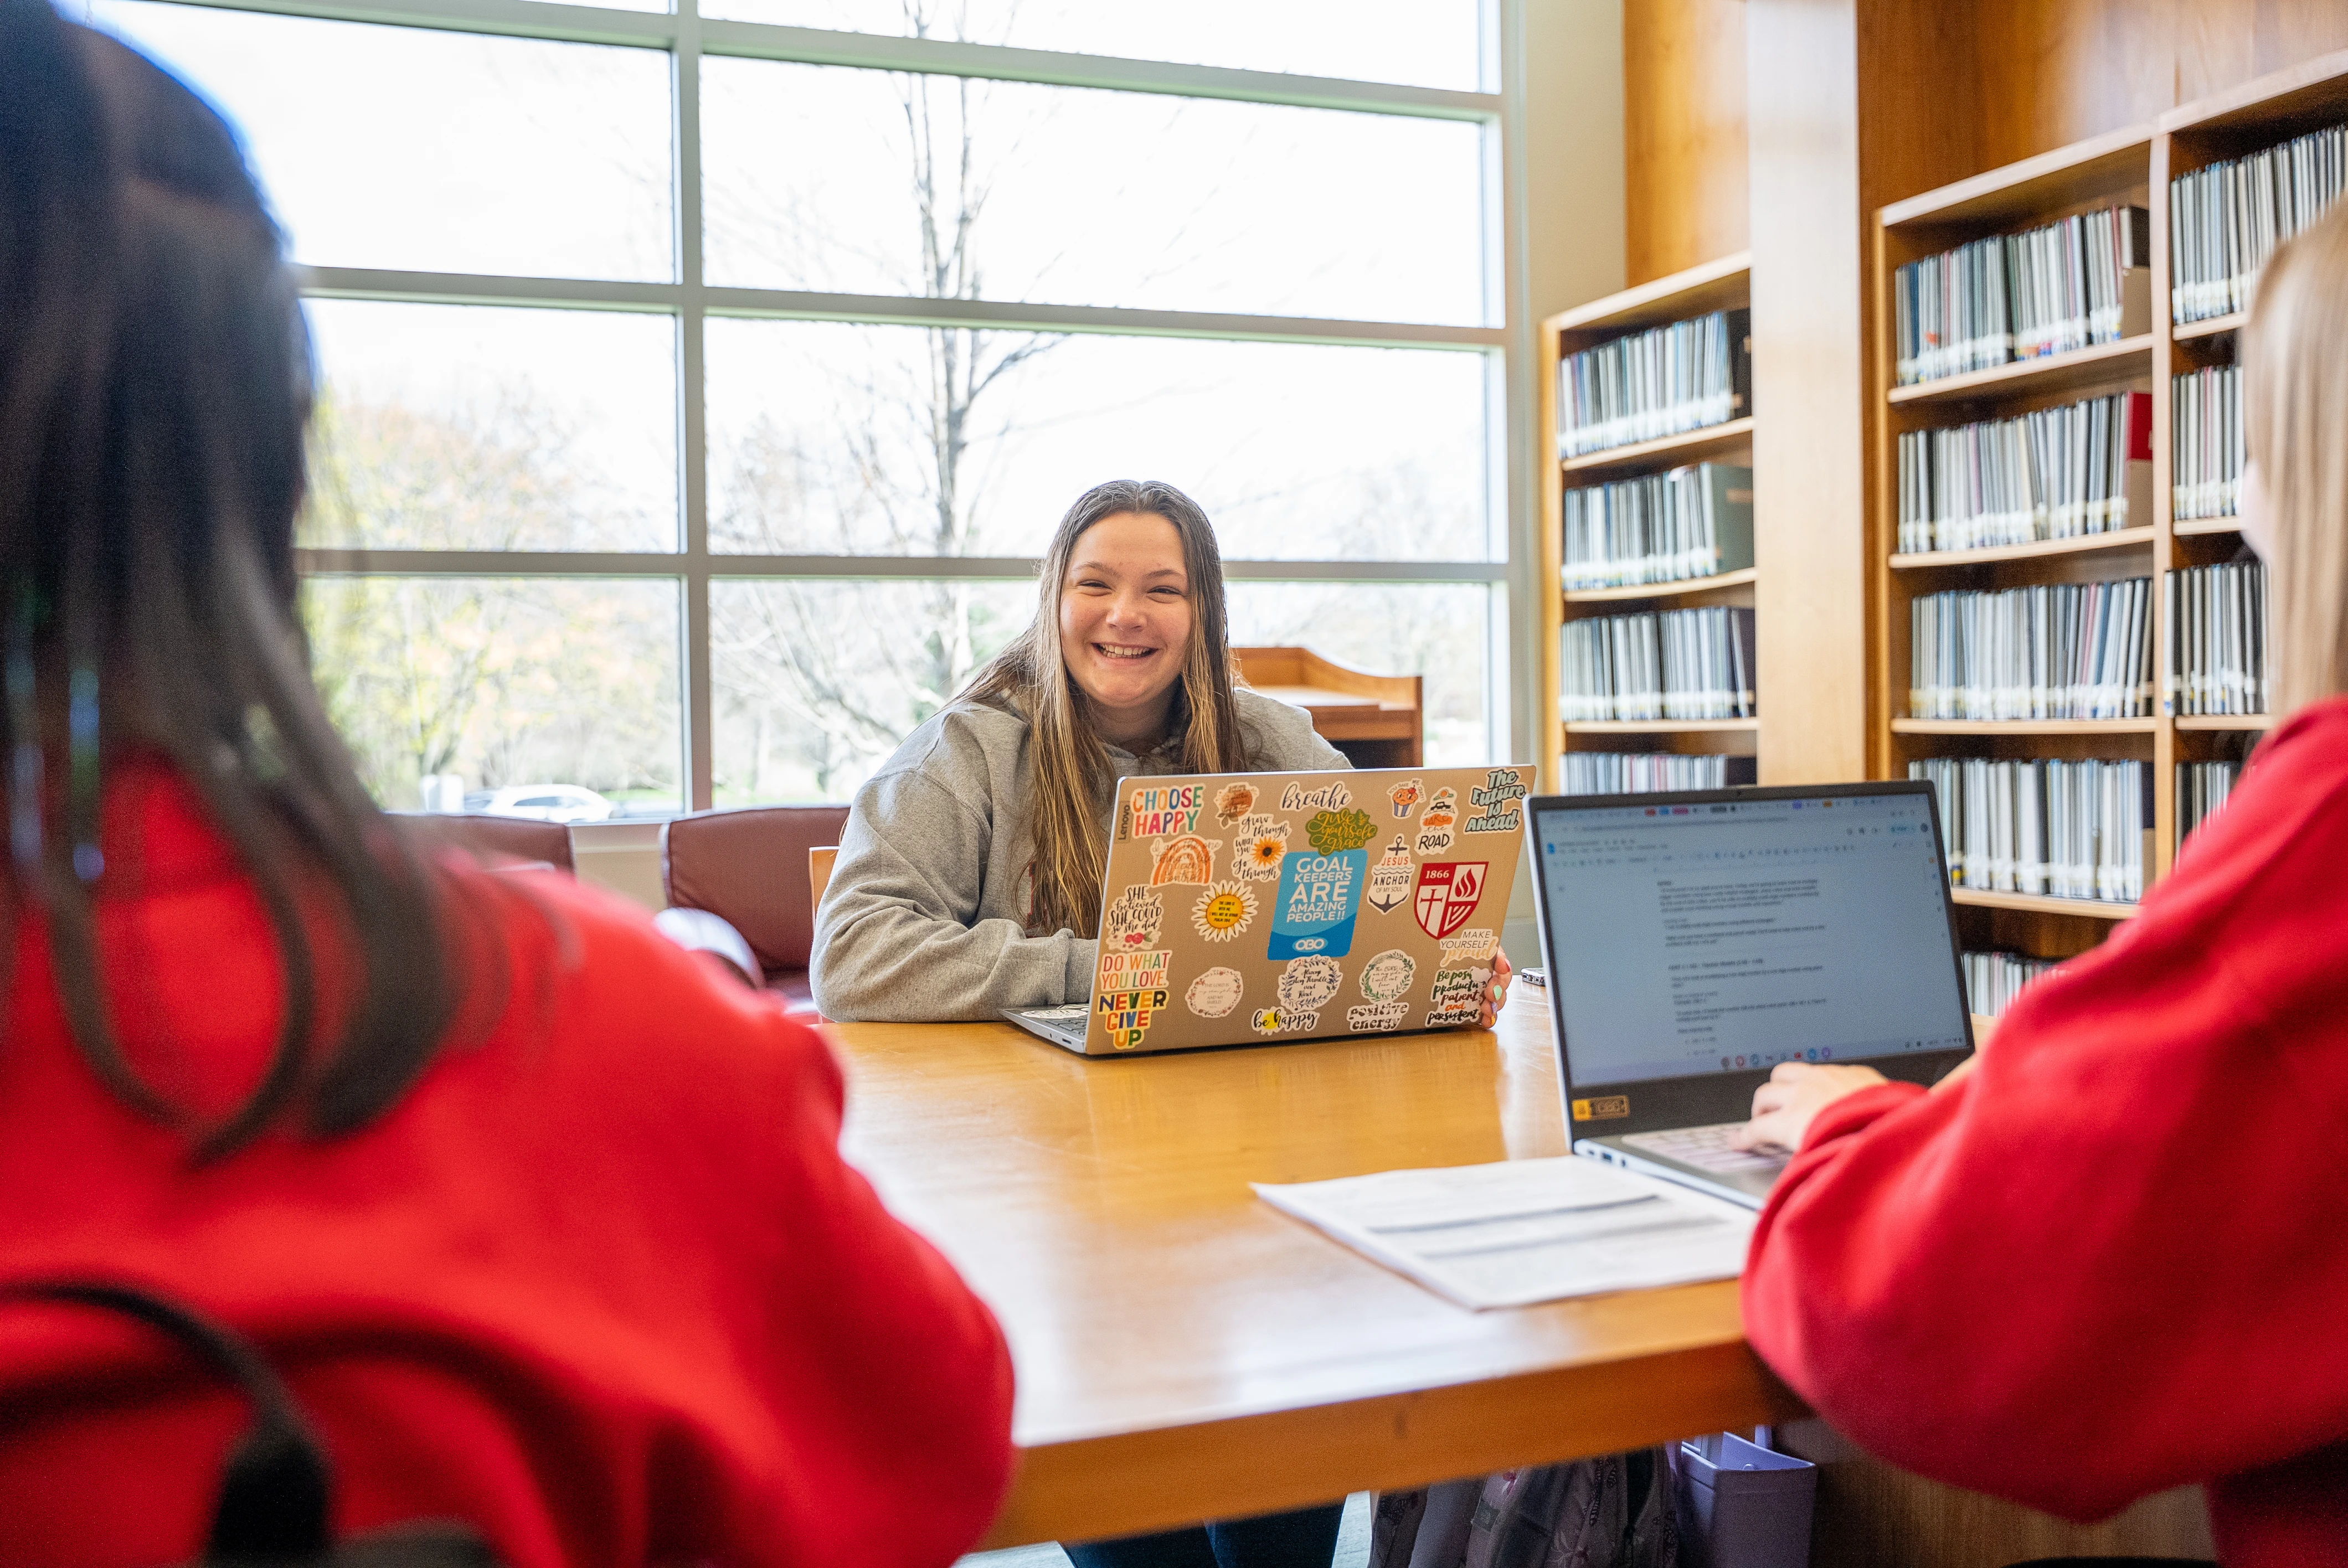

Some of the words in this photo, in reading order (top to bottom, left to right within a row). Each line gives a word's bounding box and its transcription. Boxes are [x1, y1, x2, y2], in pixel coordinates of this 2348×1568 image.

[1487, 770, 1518, 790] The
[1133, 786, 1203, 812] CHOOSE
[1282, 783, 1351, 810] breathe
[1471, 785, 1526, 807] Future
[1119, 804, 1130, 840] Lenovo
[1135, 810, 1199, 836] HAPPY
[1242, 816, 1271, 834] grow
[1465, 809, 1519, 833] Ahead
[1253, 823, 1290, 838] through
[1418, 833, 1450, 850] ROAD
[1296, 856, 1353, 873] GOAL
[1381, 856, 1409, 866] JESUS
[1242, 866, 1279, 880] through
[1294, 871, 1352, 883] KEEPERS
[1373, 875, 1409, 886] ANCHOR
[1425, 869, 1450, 879] 1866
[1126, 886, 1149, 902] SHE
[1289, 880, 1350, 904] ARE
[1116, 895, 1161, 912] believed
[1288, 901, 1347, 913] AMAZING
[1132, 907, 1162, 922] COULD
[1124, 920, 1139, 933] she
[1141, 917, 1160, 931] did
[1441, 940, 1489, 948] YOURSELF
[1441, 940, 1495, 965] proud
[1103, 955, 1124, 972] DO
[1130, 952, 1170, 970] WHAT
[1101, 973, 1129, 989] YOU
[1132, 971, 1168, 988] LOVE.
[1436, 970, 1449, 982] Be
[1099, 991, 1167, 1012] NEVER
[1444, 1001, 1466, 1012] and
[1254, 1010, 1270, 1028] be
[1273, 1009, 1317, 1029] happy
[1349, 1003, 1408, 1020] positive
[1427, 1009, 1479, 1025] persistent
[1106, 1010, 1150, 1031] GIVE
[1352, 1018, 1400, 1030] energy
[1115, 1029, 1142, 1047] UP
